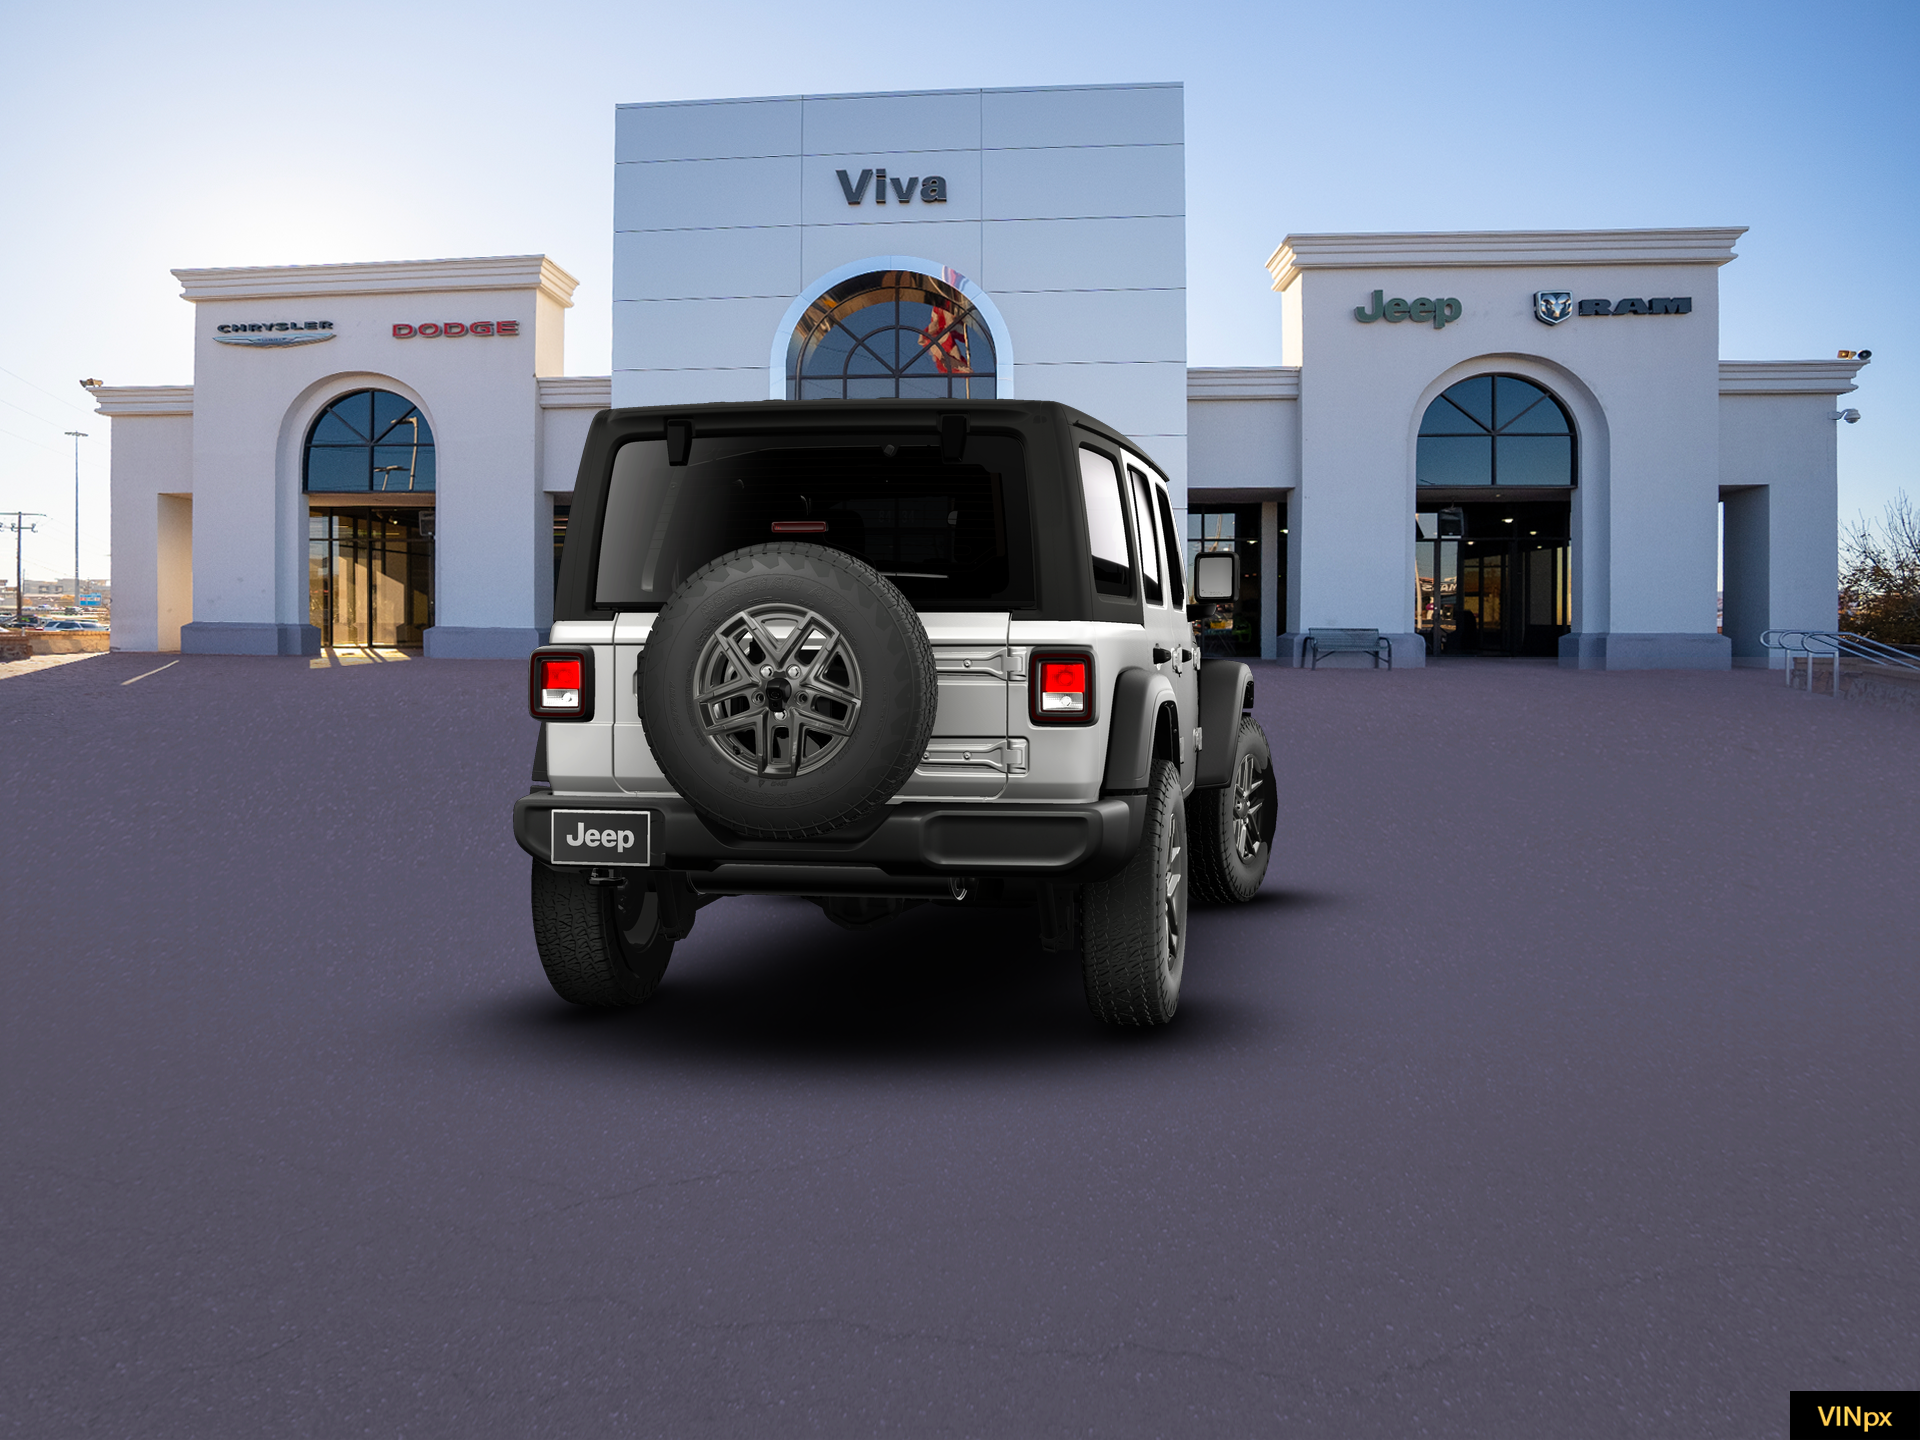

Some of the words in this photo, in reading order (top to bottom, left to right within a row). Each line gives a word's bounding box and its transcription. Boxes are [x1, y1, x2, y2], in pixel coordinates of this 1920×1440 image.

[835, 168, 947, 205] Viva
[1353, 289, 1463, 330] Jeep
[1578, 297, 1692, 316] RAM
[217, 320, 334, 333] CHRYSLER
[392, 320, 519, 339] DODGE
[566, 822, 635, 853] Jeep
